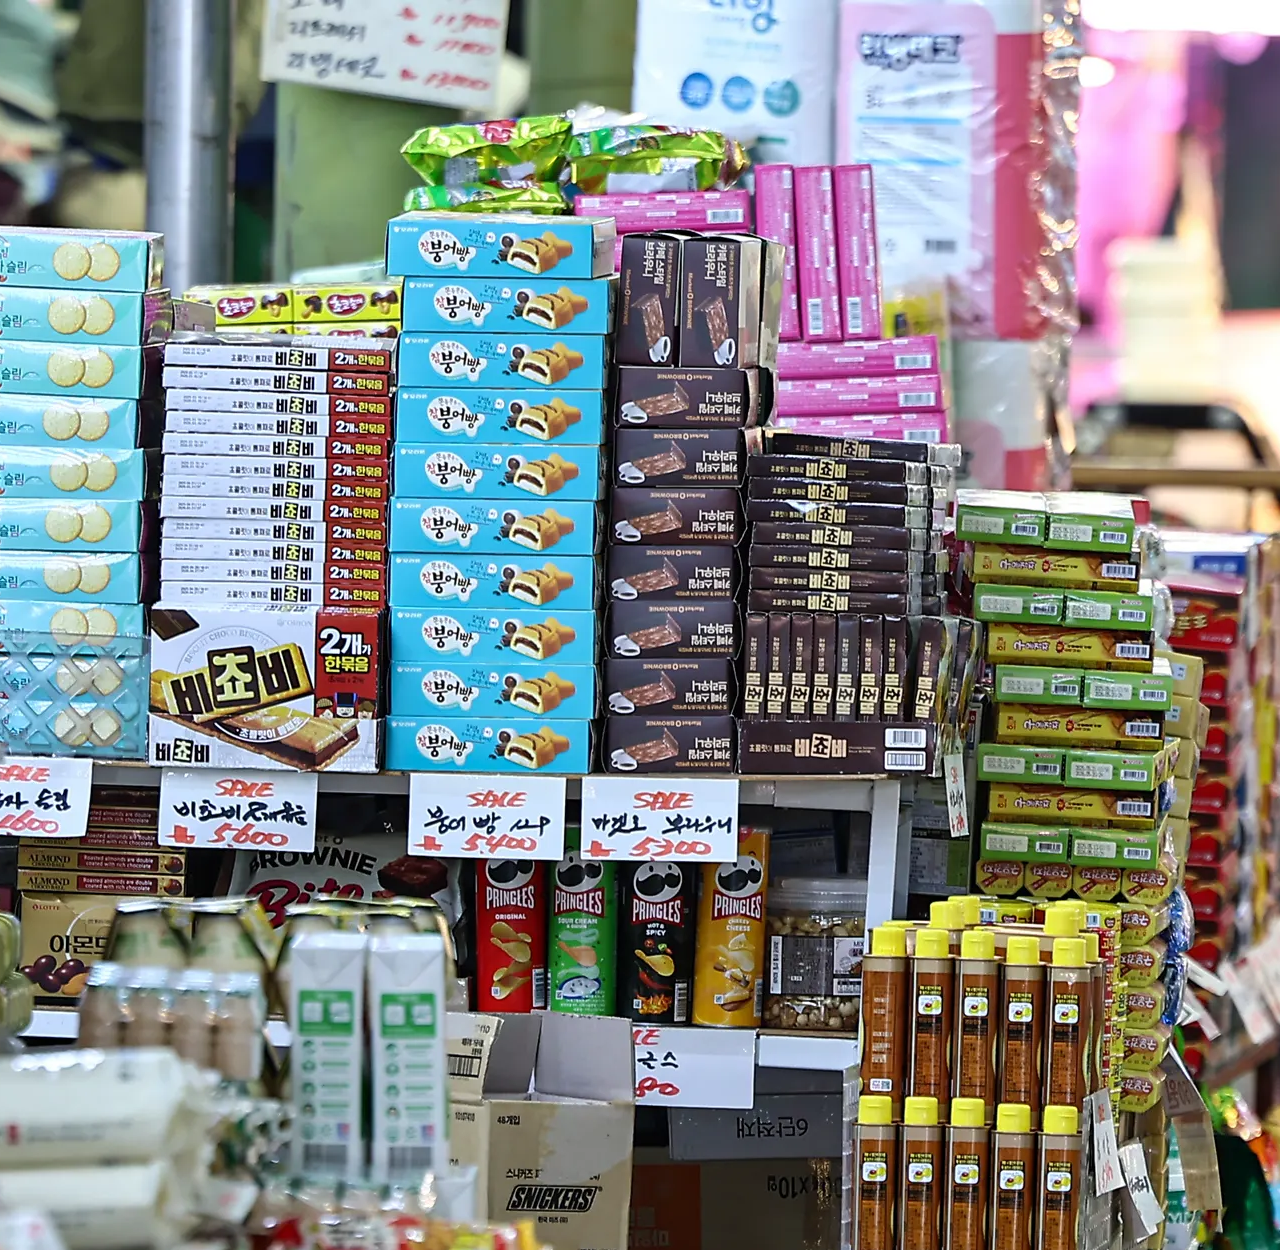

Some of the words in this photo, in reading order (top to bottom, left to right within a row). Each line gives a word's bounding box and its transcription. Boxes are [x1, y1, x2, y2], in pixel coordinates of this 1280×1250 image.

[324, 655, 370, 673] 한묶음
[170, 647, 300, 714] 비쵸비
[155, 738, 210, 763] 비쵸비
[215, 779, 274, 797] SALE
[466, 790, 527, 808] SALE
[633, 791, 694, 811] SALE
[28, 854, 70, 863] ALMOND
[249, 846, 377, 875] BROWNIE
[27, 877, 70, 886] ALMOND
[486, 886, 534, 909] PRINGLES
[555, 890, 602, 914] PRINGLES
[714, 894, 761, 918] PRINGLES
[633, 899, 680, 923] PRINGLES
[497, 1115, 520, 1125] 48개입
[737, 1116, 808, 1138] 6단적재
[506, 1168, 533, 1179] 스니커즈
[511, 1187, 595, 1210] SNICKERS
